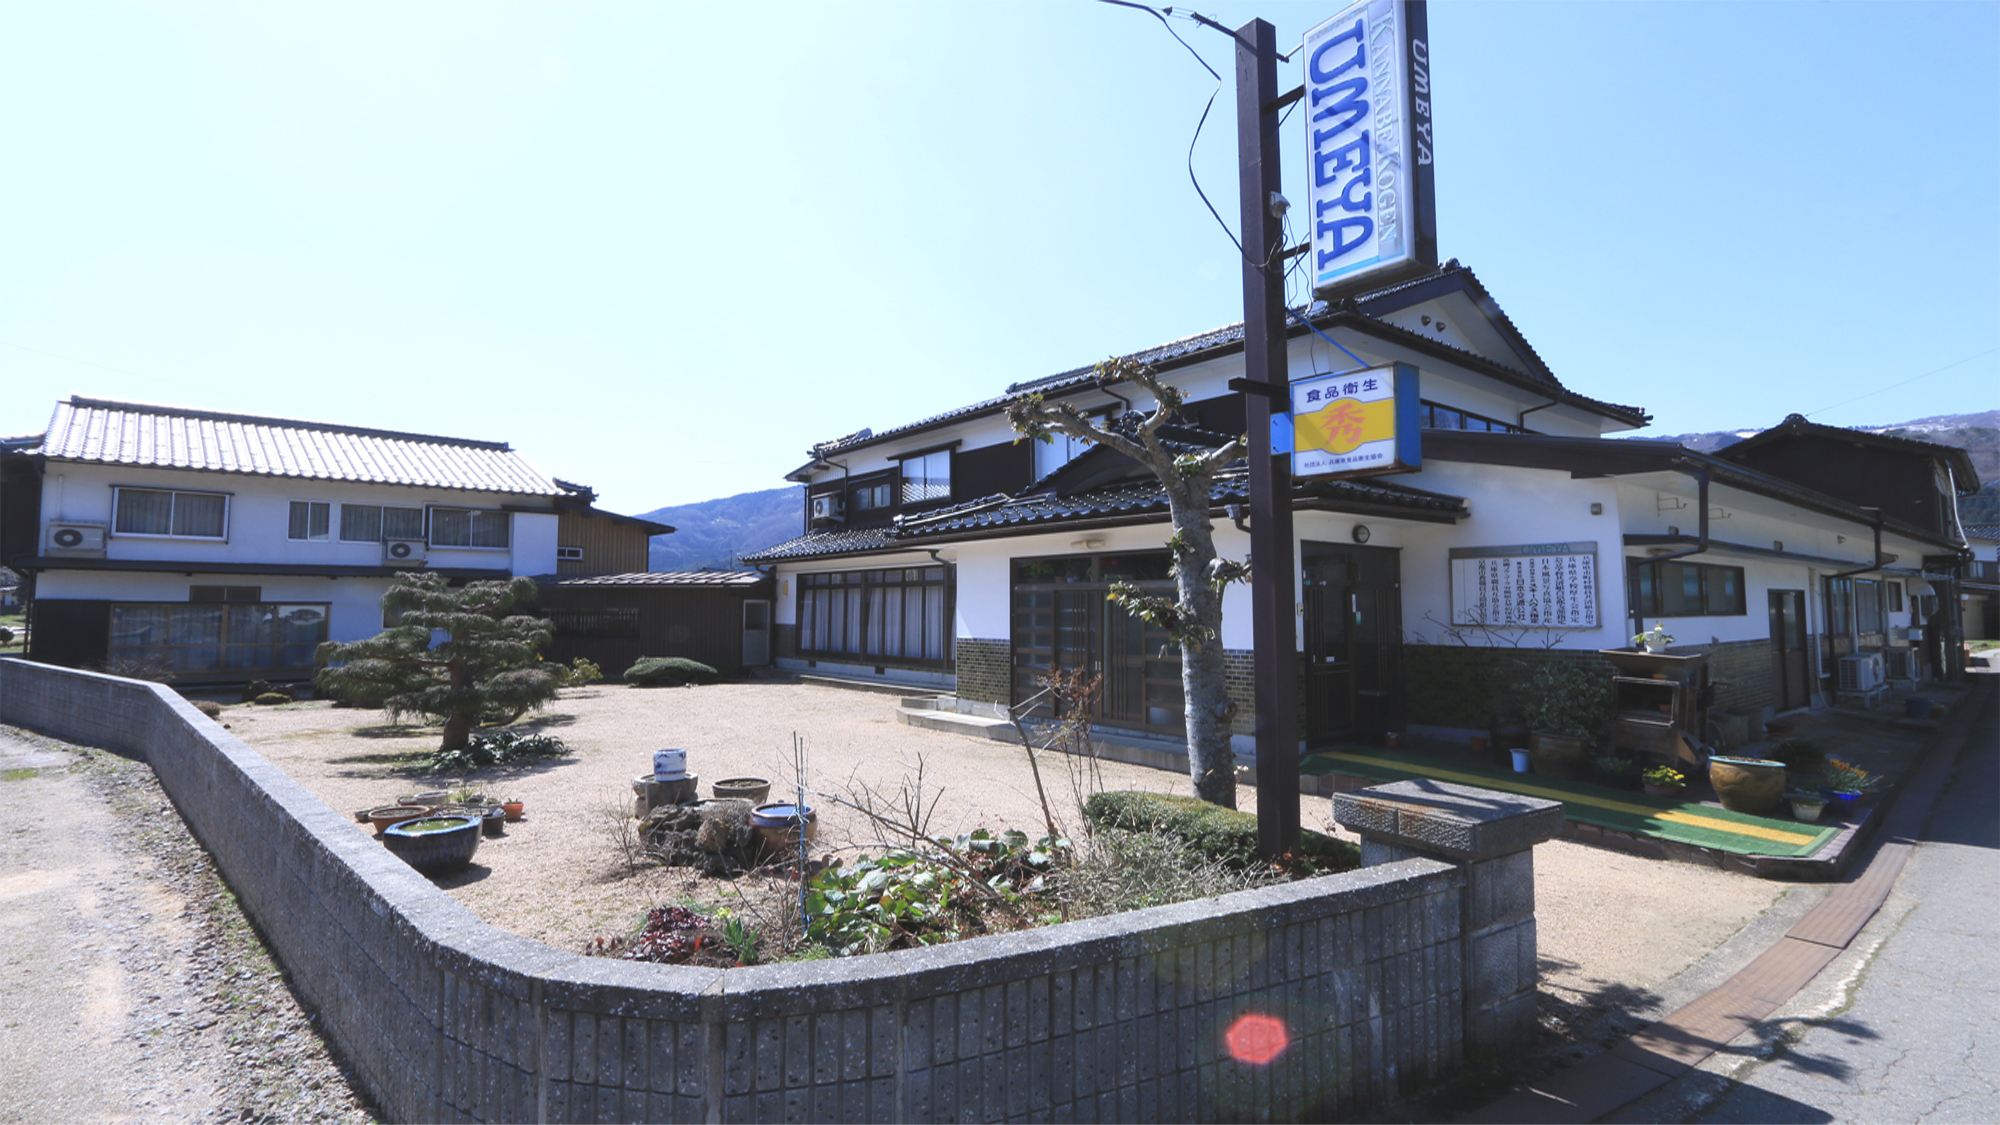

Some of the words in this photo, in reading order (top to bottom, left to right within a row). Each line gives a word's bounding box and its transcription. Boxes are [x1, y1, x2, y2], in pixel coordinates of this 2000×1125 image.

[1370, 14, 1395, 144] KANNABE
[1412, 38, 1432, 166] UMEYA
[1309, 19, 1374, 270] UMEYA
[1377, 145, 1400, 242] KOGEN
[1306, 378, 1378, 403] 食品衛生
[1319, 403, 1367, 446] 秀
